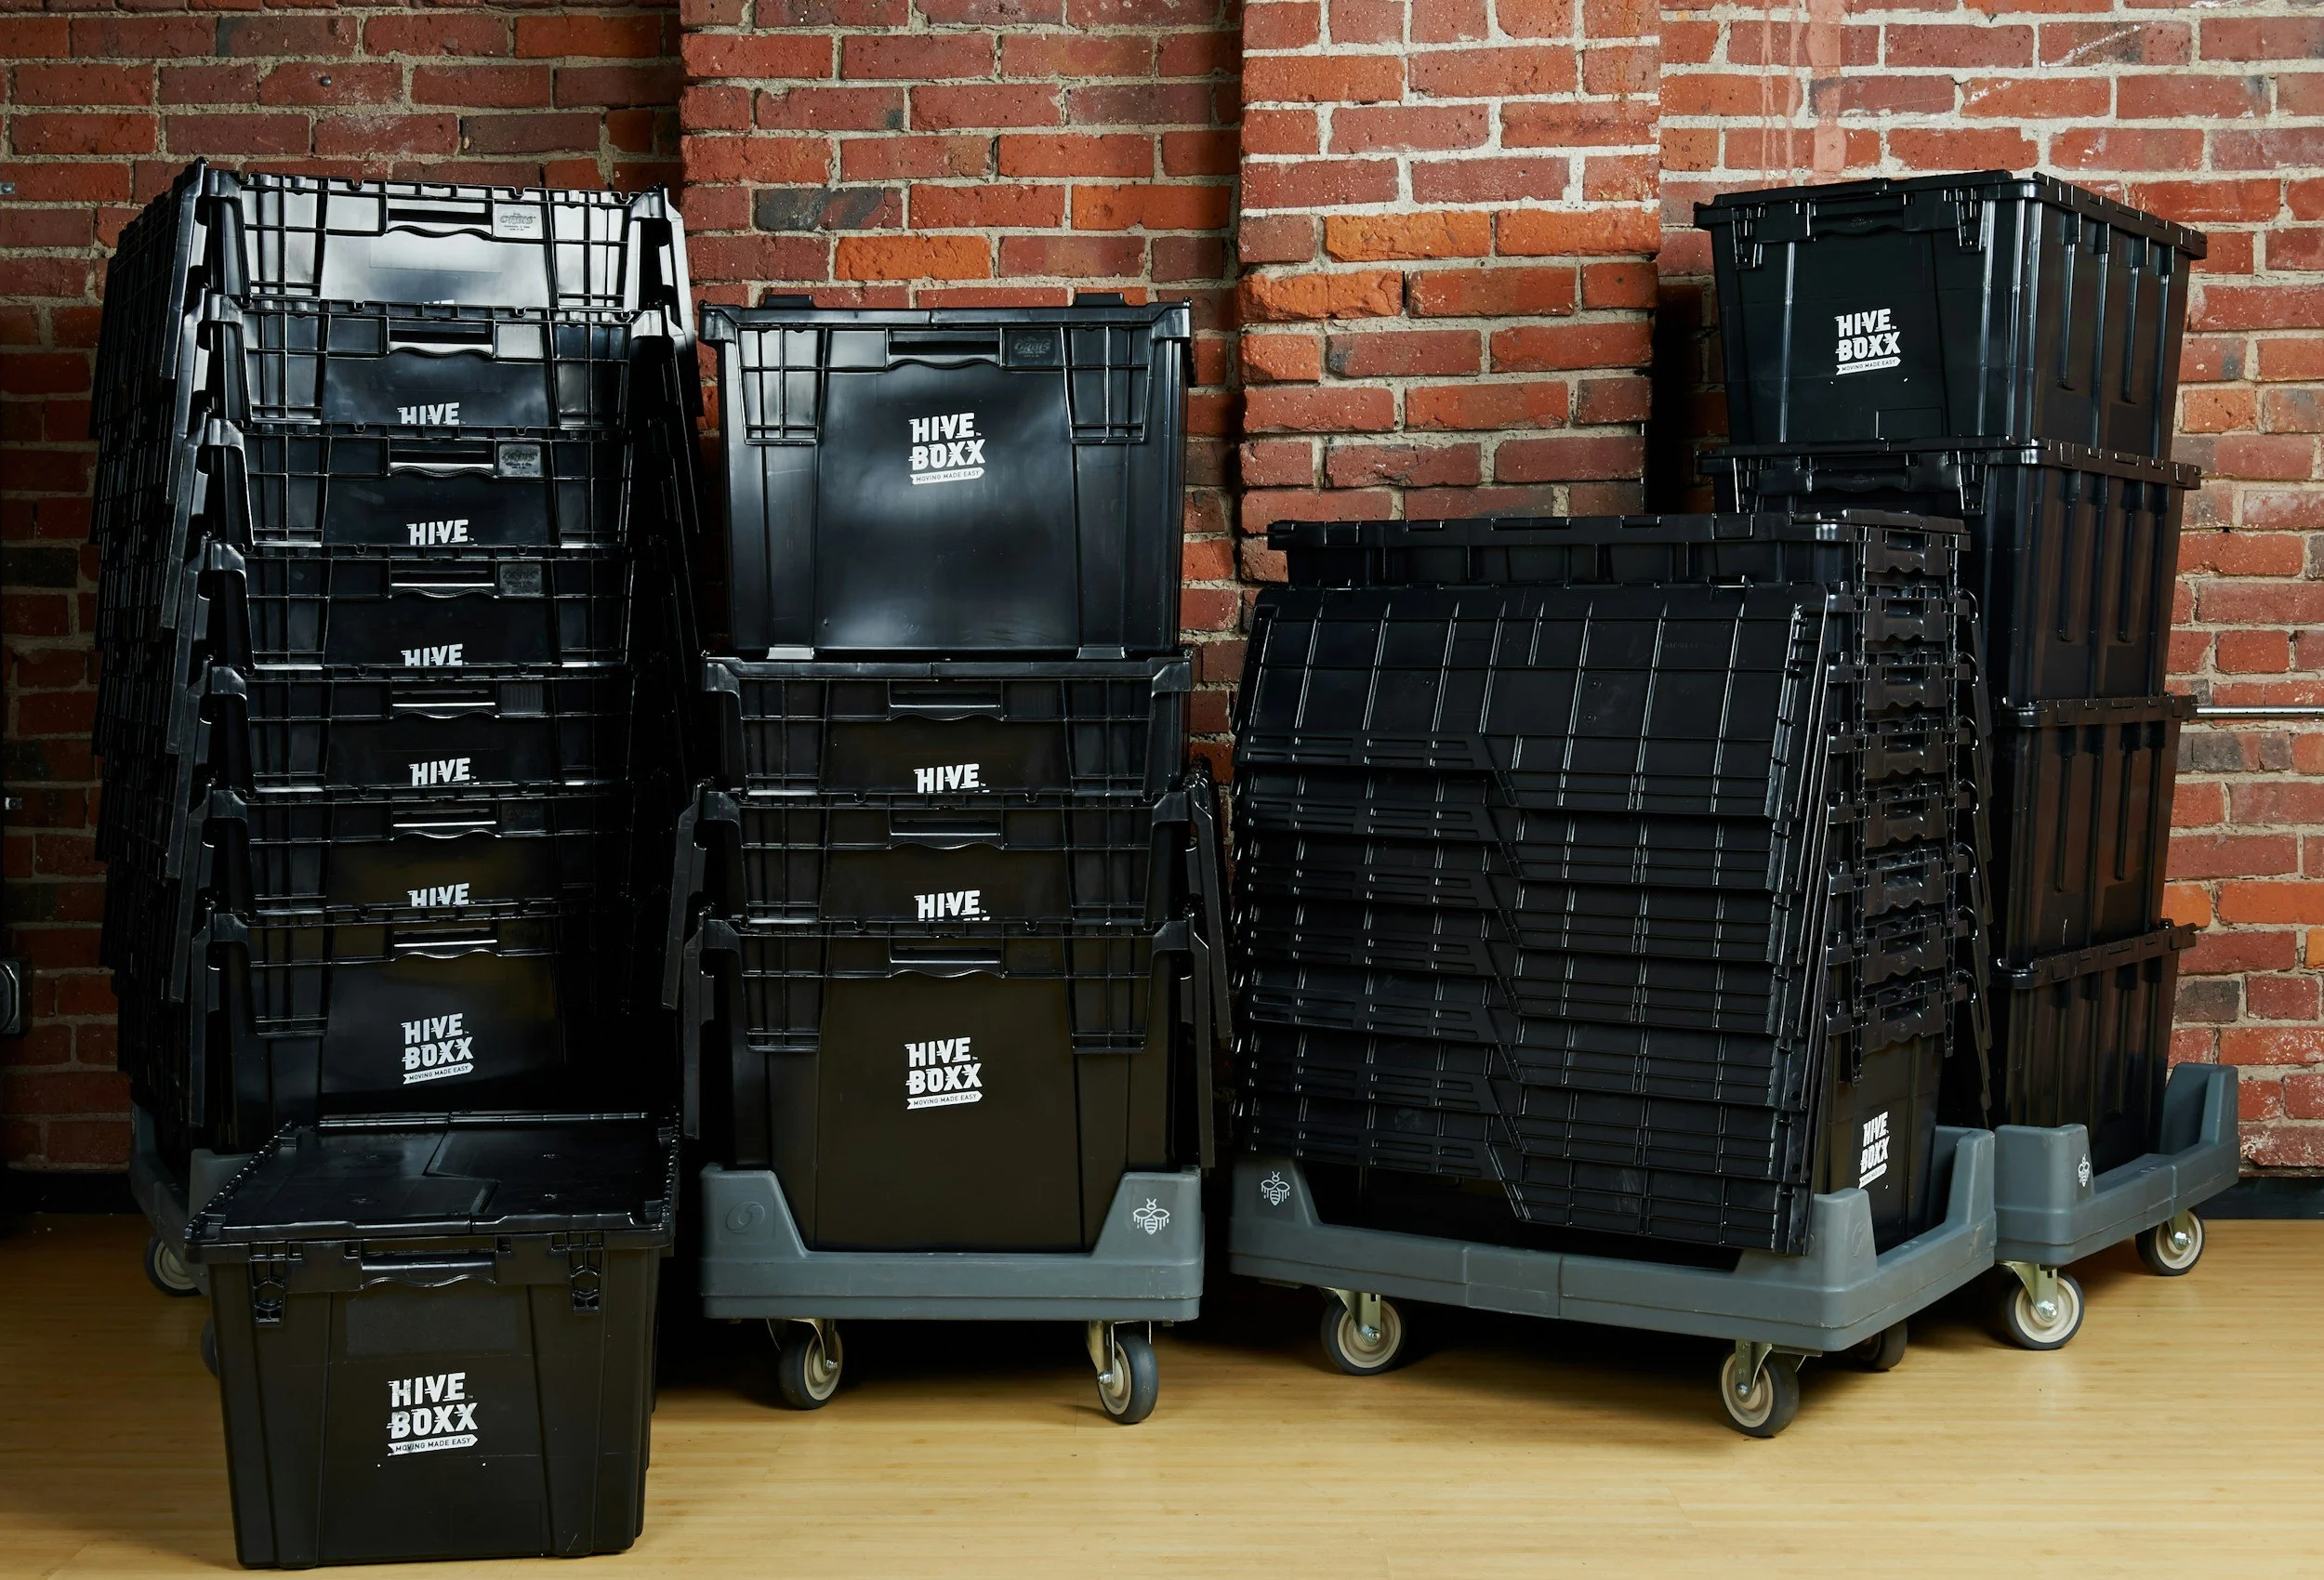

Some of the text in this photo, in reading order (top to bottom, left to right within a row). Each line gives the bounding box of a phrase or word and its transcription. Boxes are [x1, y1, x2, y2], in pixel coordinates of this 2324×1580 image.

[1834, 309, 1891, 337] HIVE
[1835, 331, 1901, 362] BOXX
[1842, 363, 1864, 372] MOVING
[397, 402, 459, 425] HIVE
[908, 413, 974, 443] HIVE
[908, 439, 985, 470] BOXX
[916, 474, 942, 482] MOVING
[943, 471, 962, 480] MADE
[406, 520, 469, 546] HIVE
[401, 643, 463, 665] HIVE
[408, 757, 470, 786] HIVE
[913, 763, 980, 793] HIVE
[407, 883, 469, 906] HIVE
[914, 890, 981, 919] HIVE
[401, 1013, 463, 1045] HIVE
[402, 1036, 474, 1071] BOXX
[905, 1037, 971, 1067] HIVE
[409, 1073, 433, 1081] MOVING
[453, 1065, 469, 1073] EASY
[905, 1063, 983, 1095] BOXX
[913, 1098, 939, 1106] MOVING
[1863, 1112, 1888, 1147] HIVE
[1860, 1136, 1890, 1174] BOXX
[388, 1372, 466, 1408] HIVE
[387, 1402, 478, 1440] BOXX
[395, 1437, 471, 1452] MOVING MADE EASY
